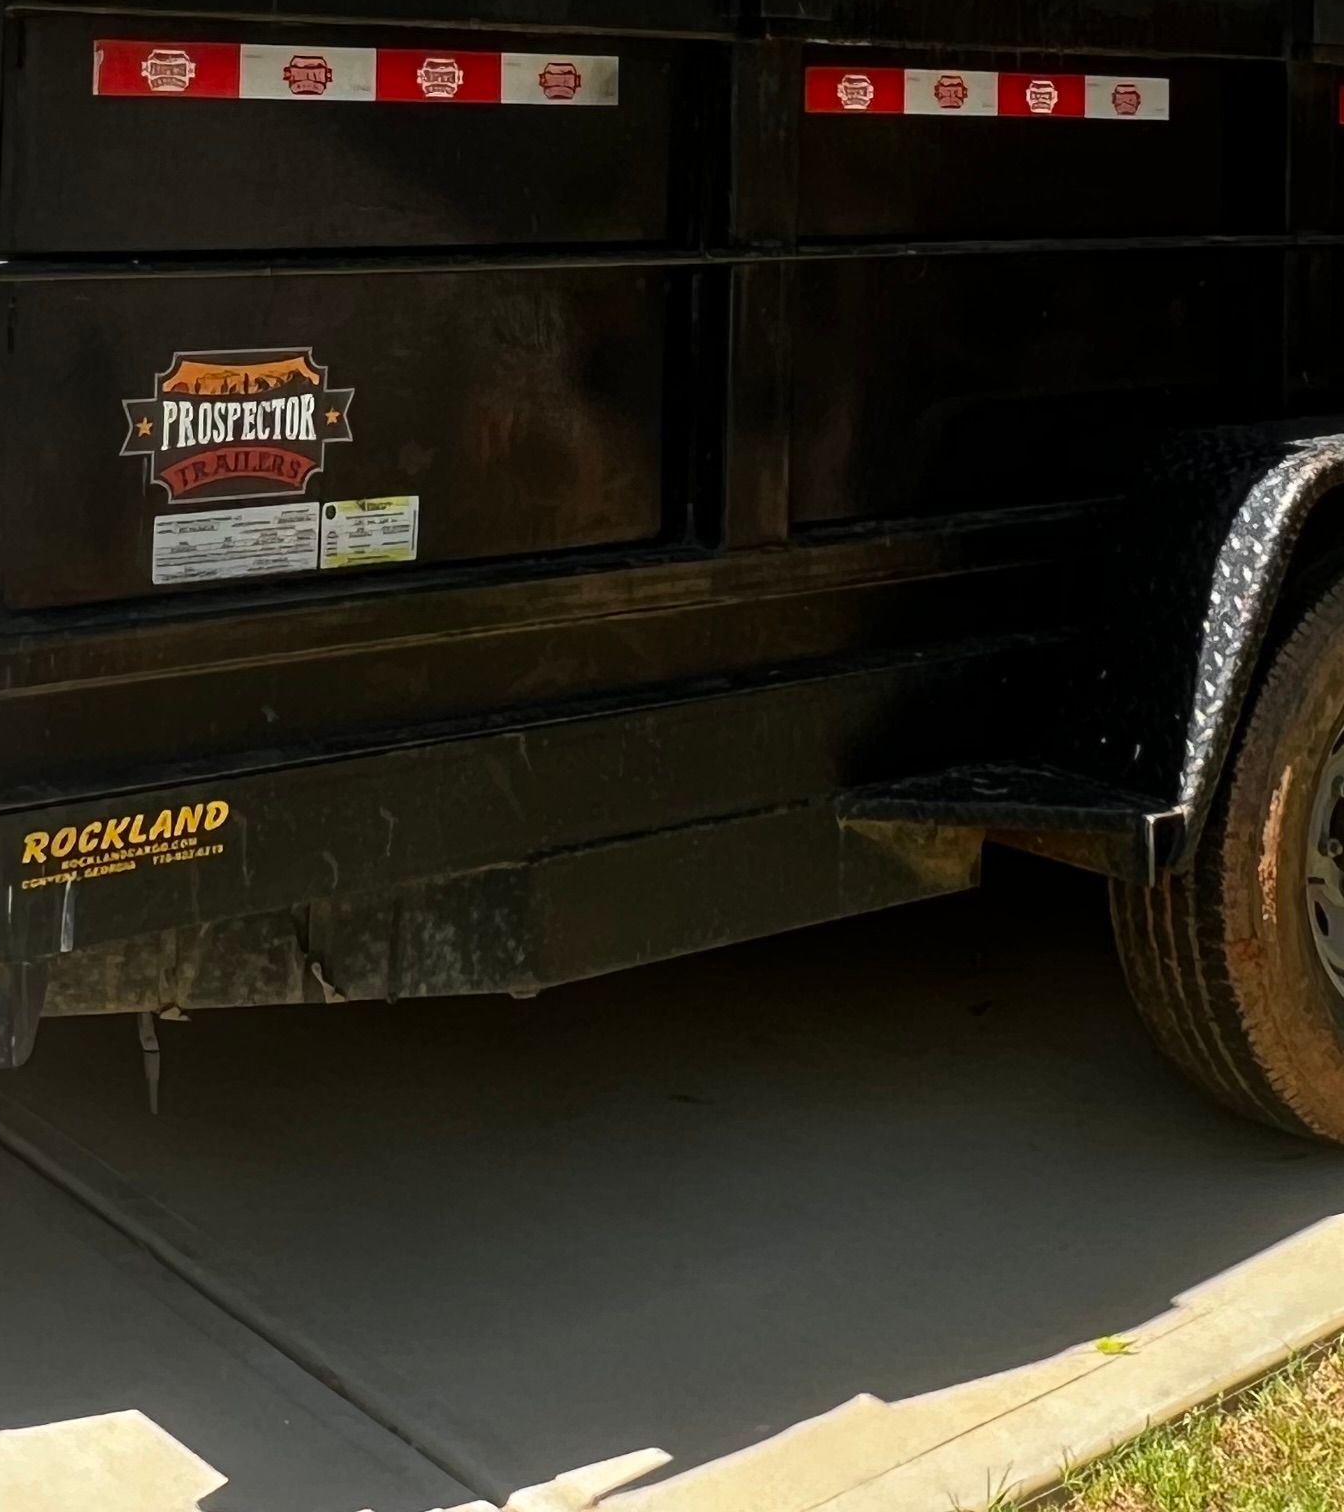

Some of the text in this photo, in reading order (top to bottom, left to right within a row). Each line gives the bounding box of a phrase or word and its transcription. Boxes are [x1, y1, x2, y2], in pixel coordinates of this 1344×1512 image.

[161, 393, 317, 451] PROSPECTOR
[174, 452, 302, 488] TRAILERS
[22, 800, 229, 864] ROCKLAND
